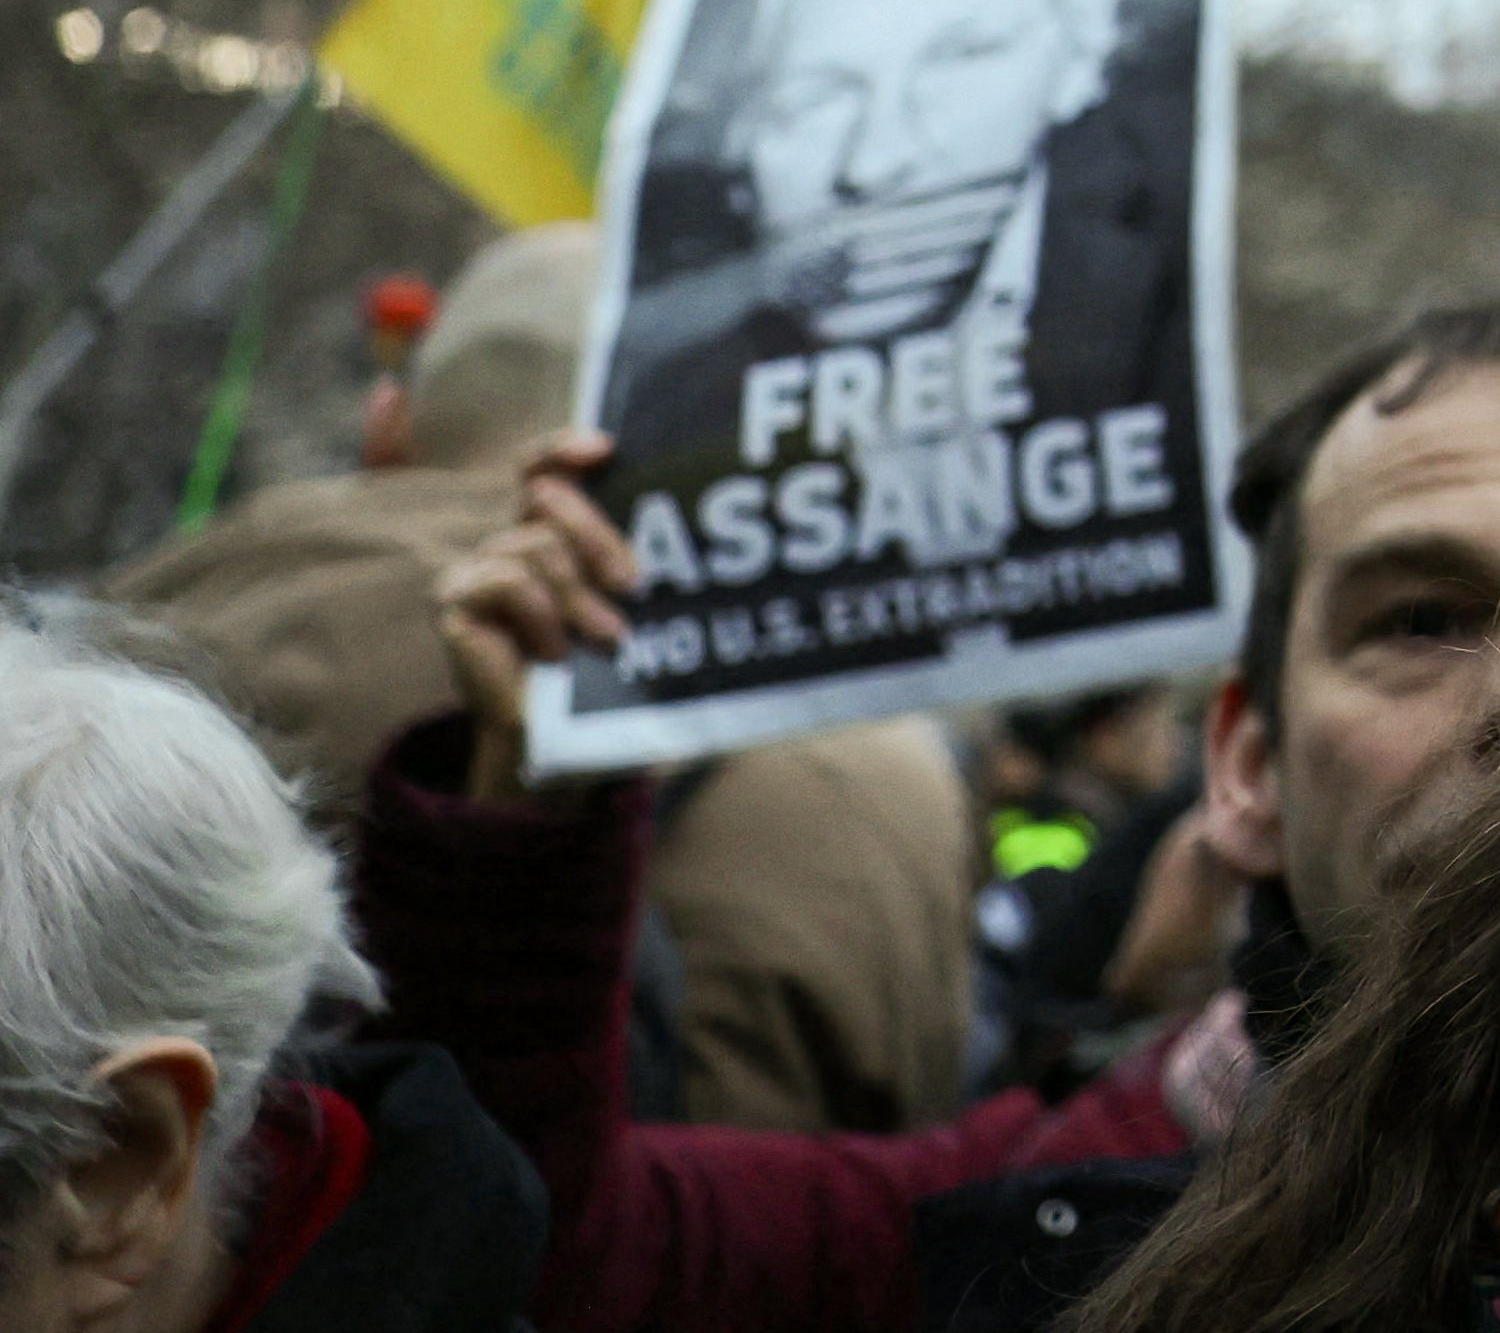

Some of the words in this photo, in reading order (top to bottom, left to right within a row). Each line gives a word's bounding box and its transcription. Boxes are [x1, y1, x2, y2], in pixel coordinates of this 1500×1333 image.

[740, 323, 1030, 466] FREE
[630, 403, 1174, 593] ASSANGE
[616, 615, 702, 683] NO
[822, 533, 1184, 645] EXTRADITION
